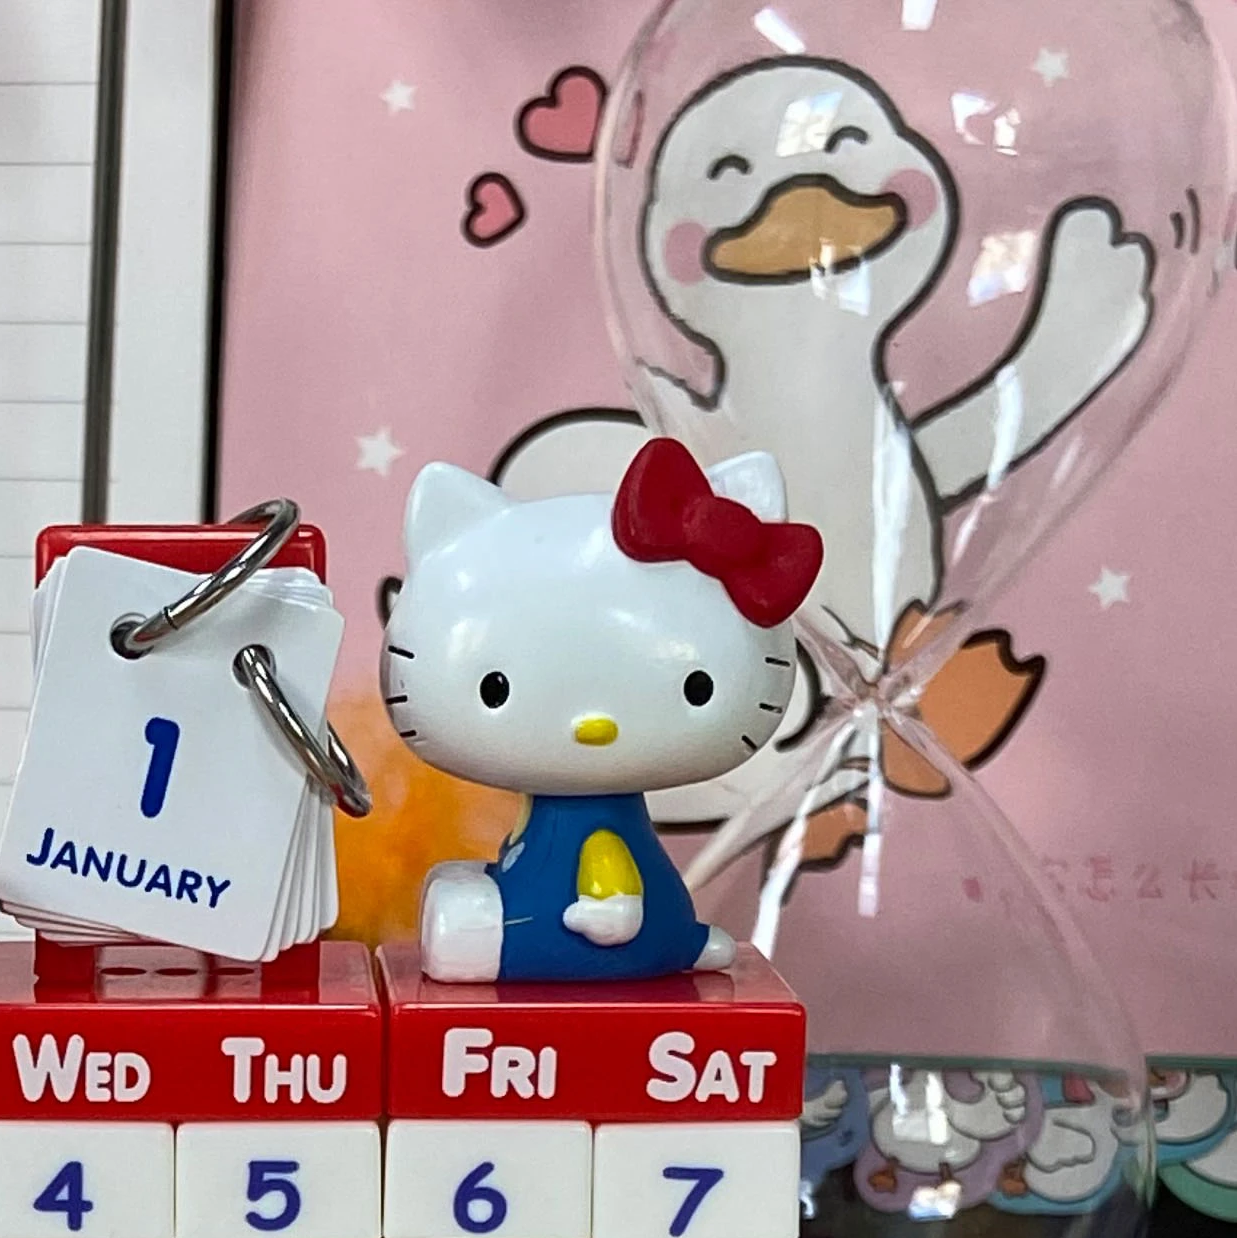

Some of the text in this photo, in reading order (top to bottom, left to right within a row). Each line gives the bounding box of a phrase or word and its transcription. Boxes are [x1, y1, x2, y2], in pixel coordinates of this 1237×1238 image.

[138, 715, 182, 820] 1
[25, 826, 232, 908] JANUARY
[12, 1034, 347, 1104] WED THU
[442, 1028, 777, 1103] FRI SAT
[33, 1159, 95, 1231] 4
[246, 1158, 303, 1233] 5
[453, 1162, 509, 1234] 6
[664, 1164, 726, 1237] 7
